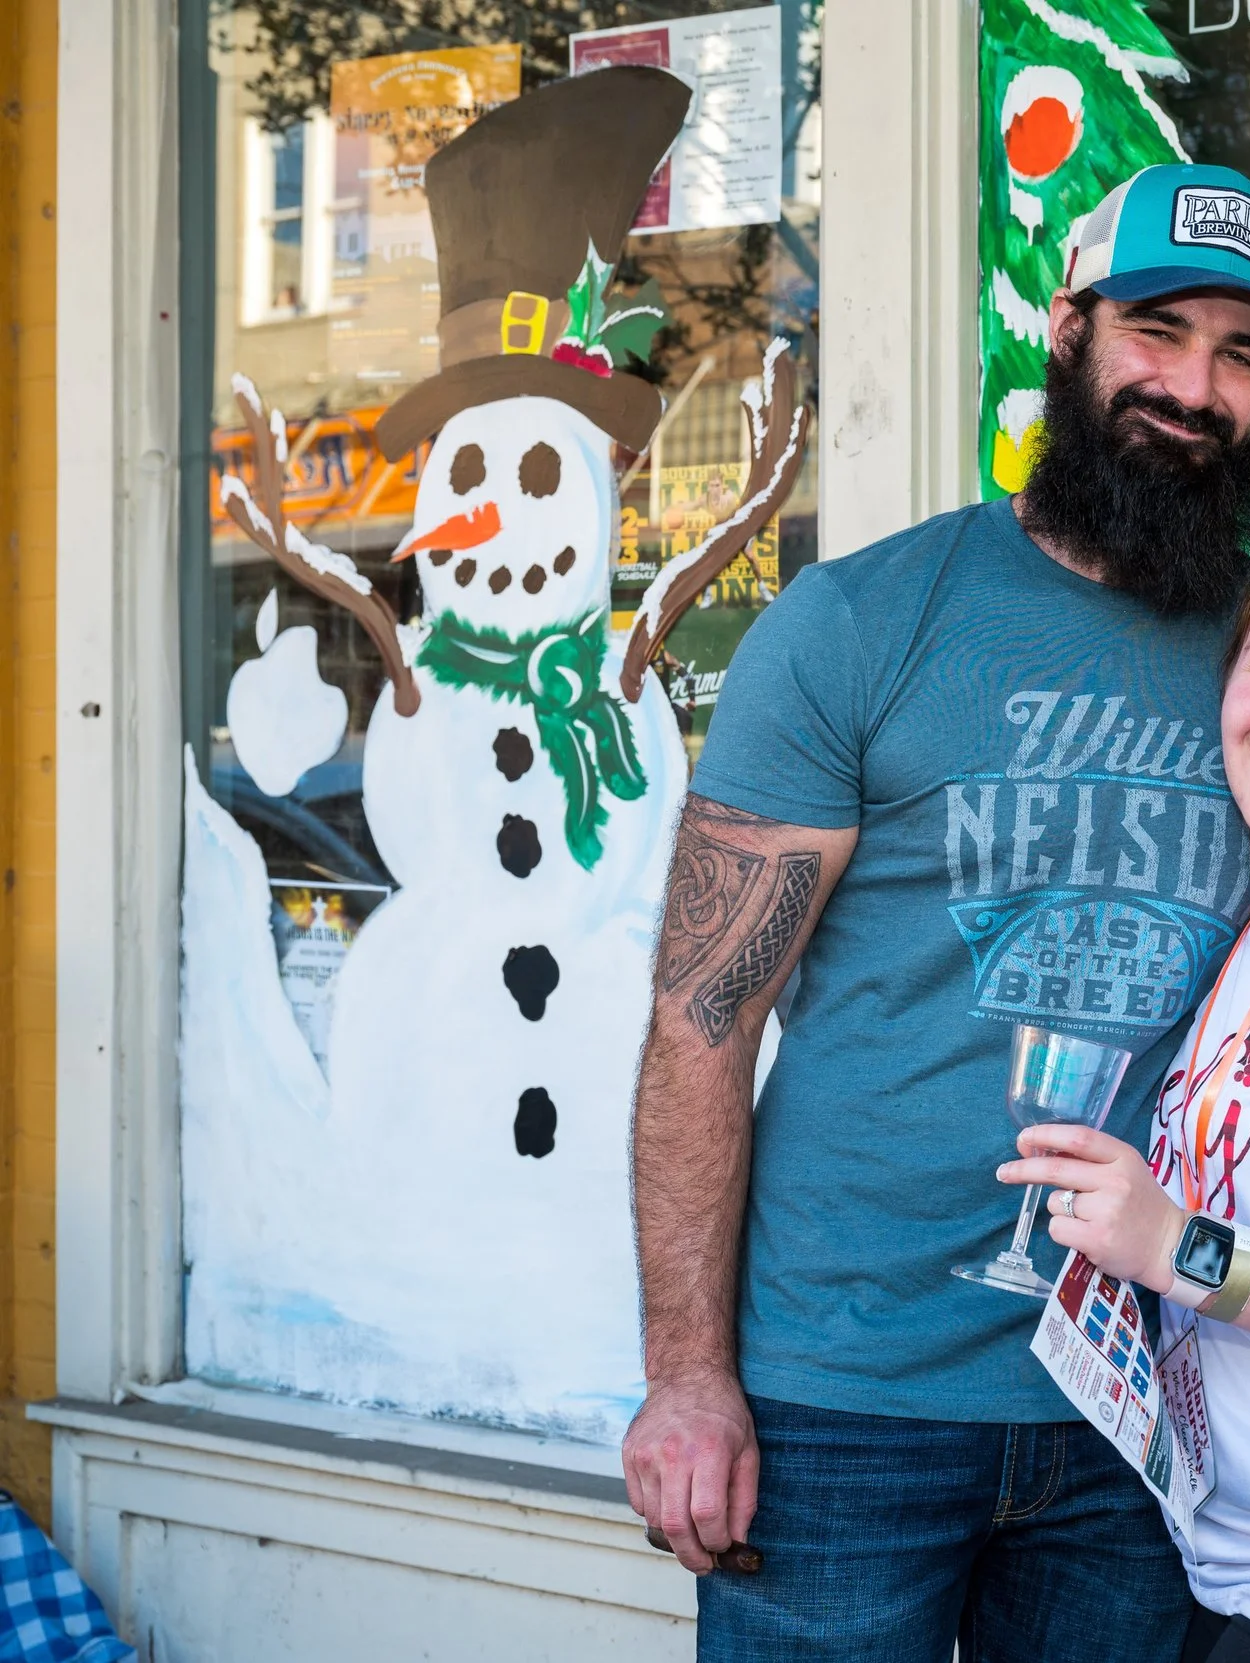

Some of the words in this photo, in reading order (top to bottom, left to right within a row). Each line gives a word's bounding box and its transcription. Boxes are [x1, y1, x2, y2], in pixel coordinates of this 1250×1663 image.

[1004, 690, 1225, 786] Willie
[1033, 909, 1182, 955] LAST
[1036, 950, 1079, 970] OF
[1088, 954, 1163, 979] THE
[994, 971, 1183, 1019] BREED
[1191, 1366, 1210, 1450] Starry
[1178, 1414, 1190, 1455] Cheese
